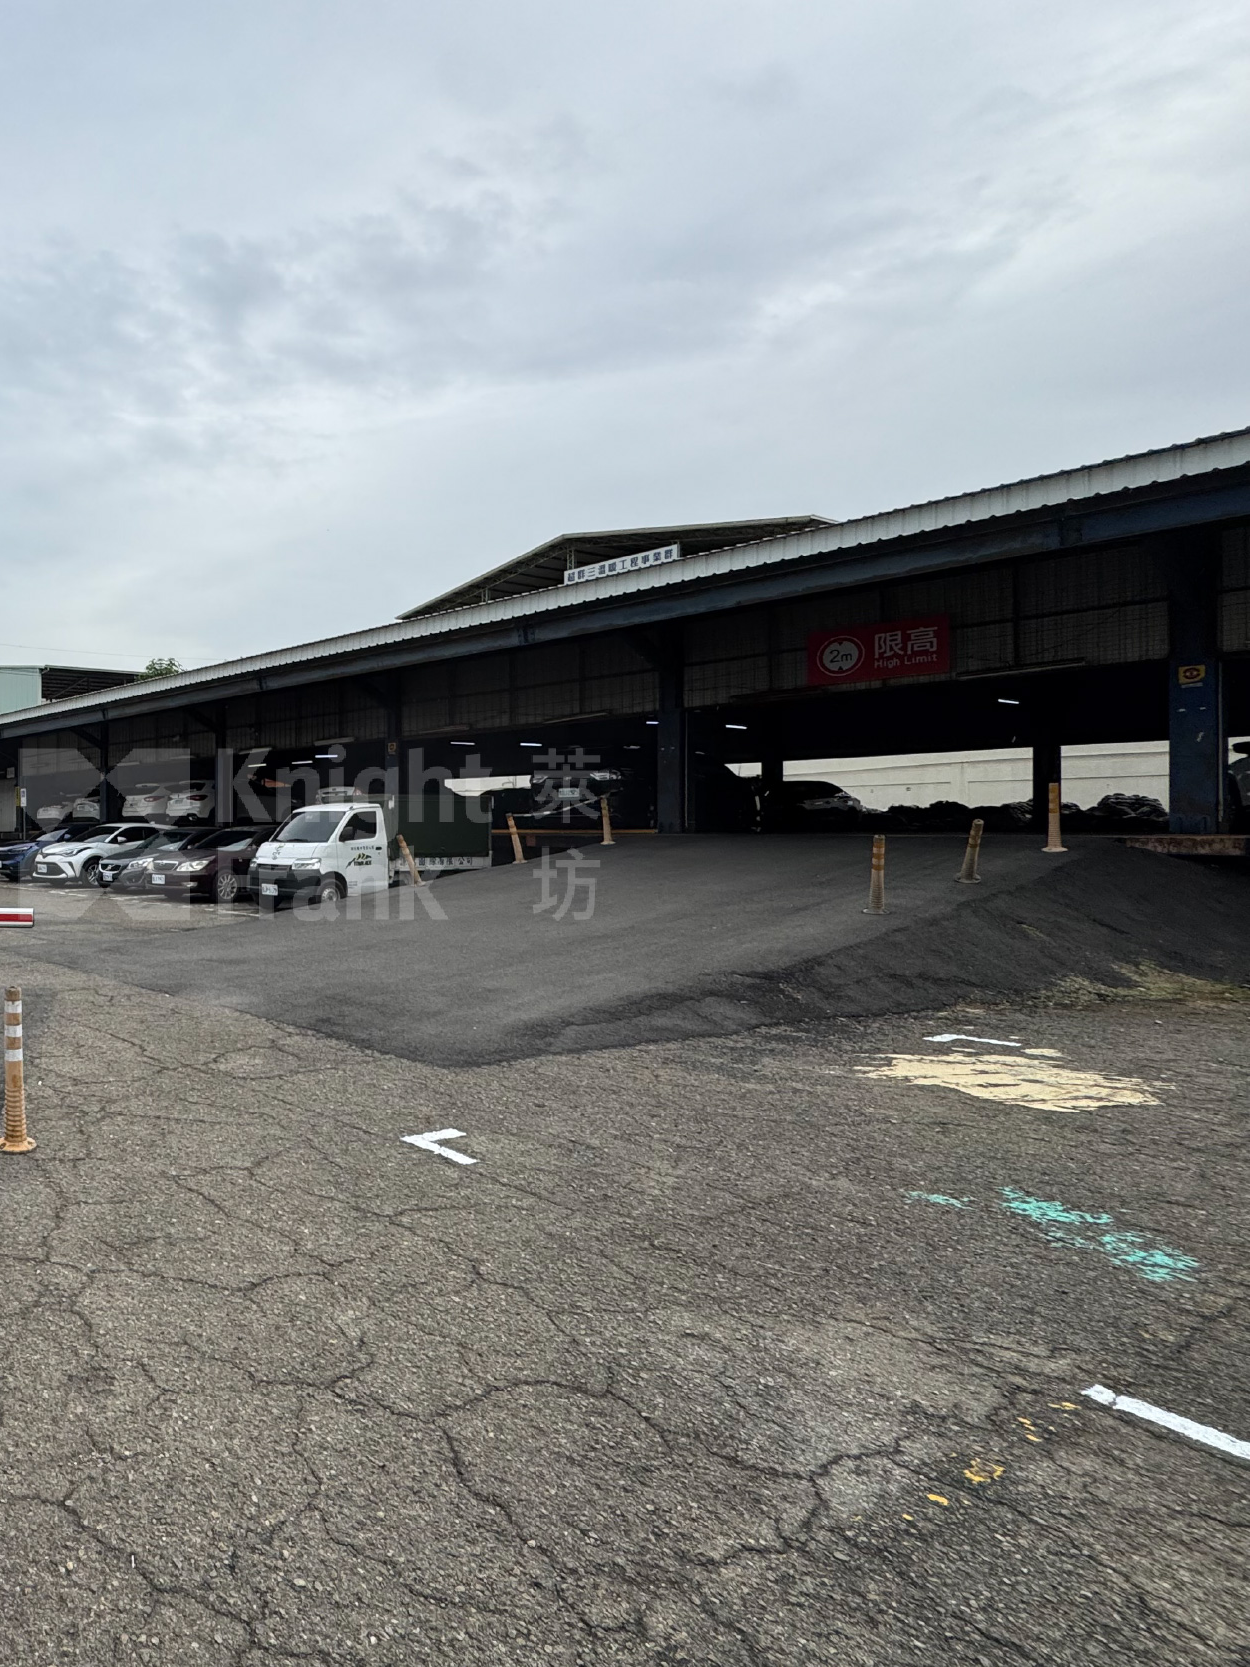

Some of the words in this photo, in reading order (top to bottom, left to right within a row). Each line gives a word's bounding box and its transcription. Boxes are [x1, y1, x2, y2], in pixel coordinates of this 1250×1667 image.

[874, 626, 938, 658] 限高
[829, 648, 853, 664] 2m
[874, 657, 900, 669] High
[904, 653, 938, 665] Limit
